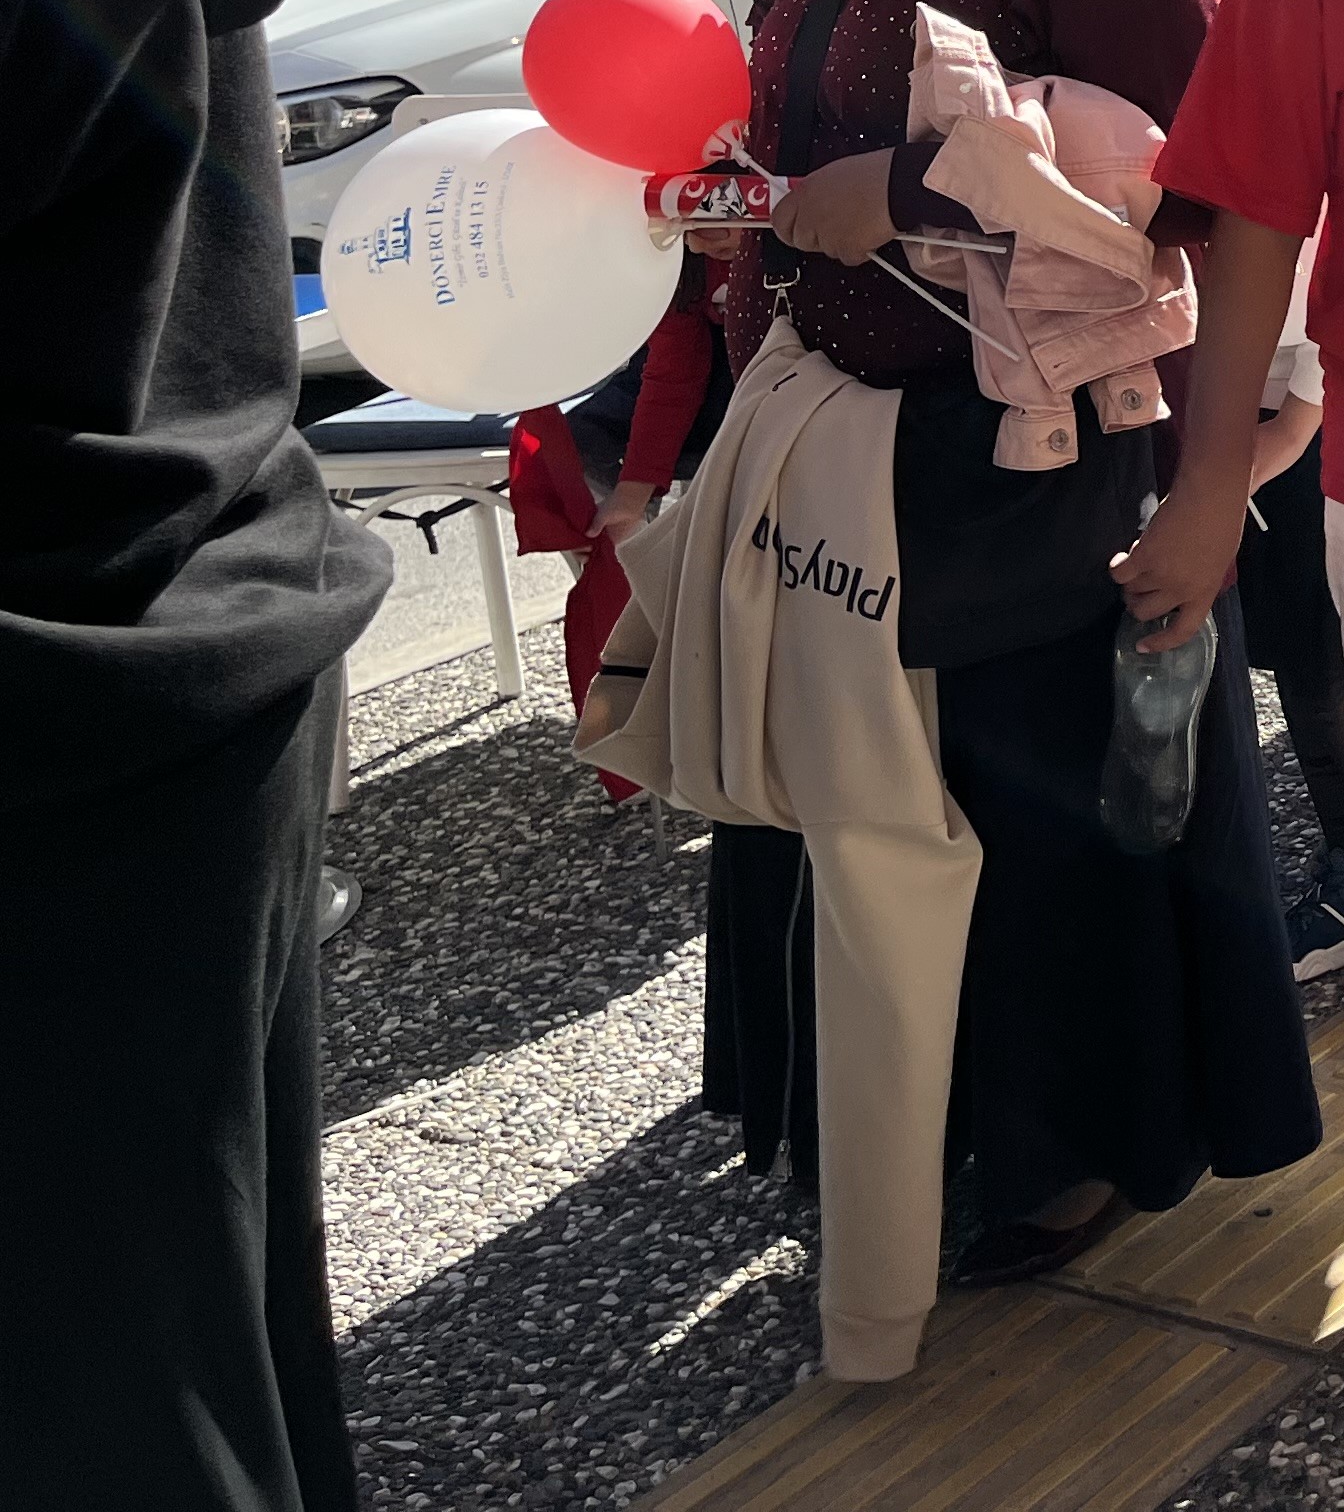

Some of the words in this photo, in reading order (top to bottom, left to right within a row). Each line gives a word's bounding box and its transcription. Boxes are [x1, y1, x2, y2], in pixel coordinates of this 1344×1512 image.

[425, 165, 457, 215] EMRE
[473, 180, 490, 195] 15
[470, 201, 484, 217] 13
[469, 222, 484, 250] 484
[424, 219, 456, 306] DÖNERCİ
[474, 252, 490, 279] 0232
